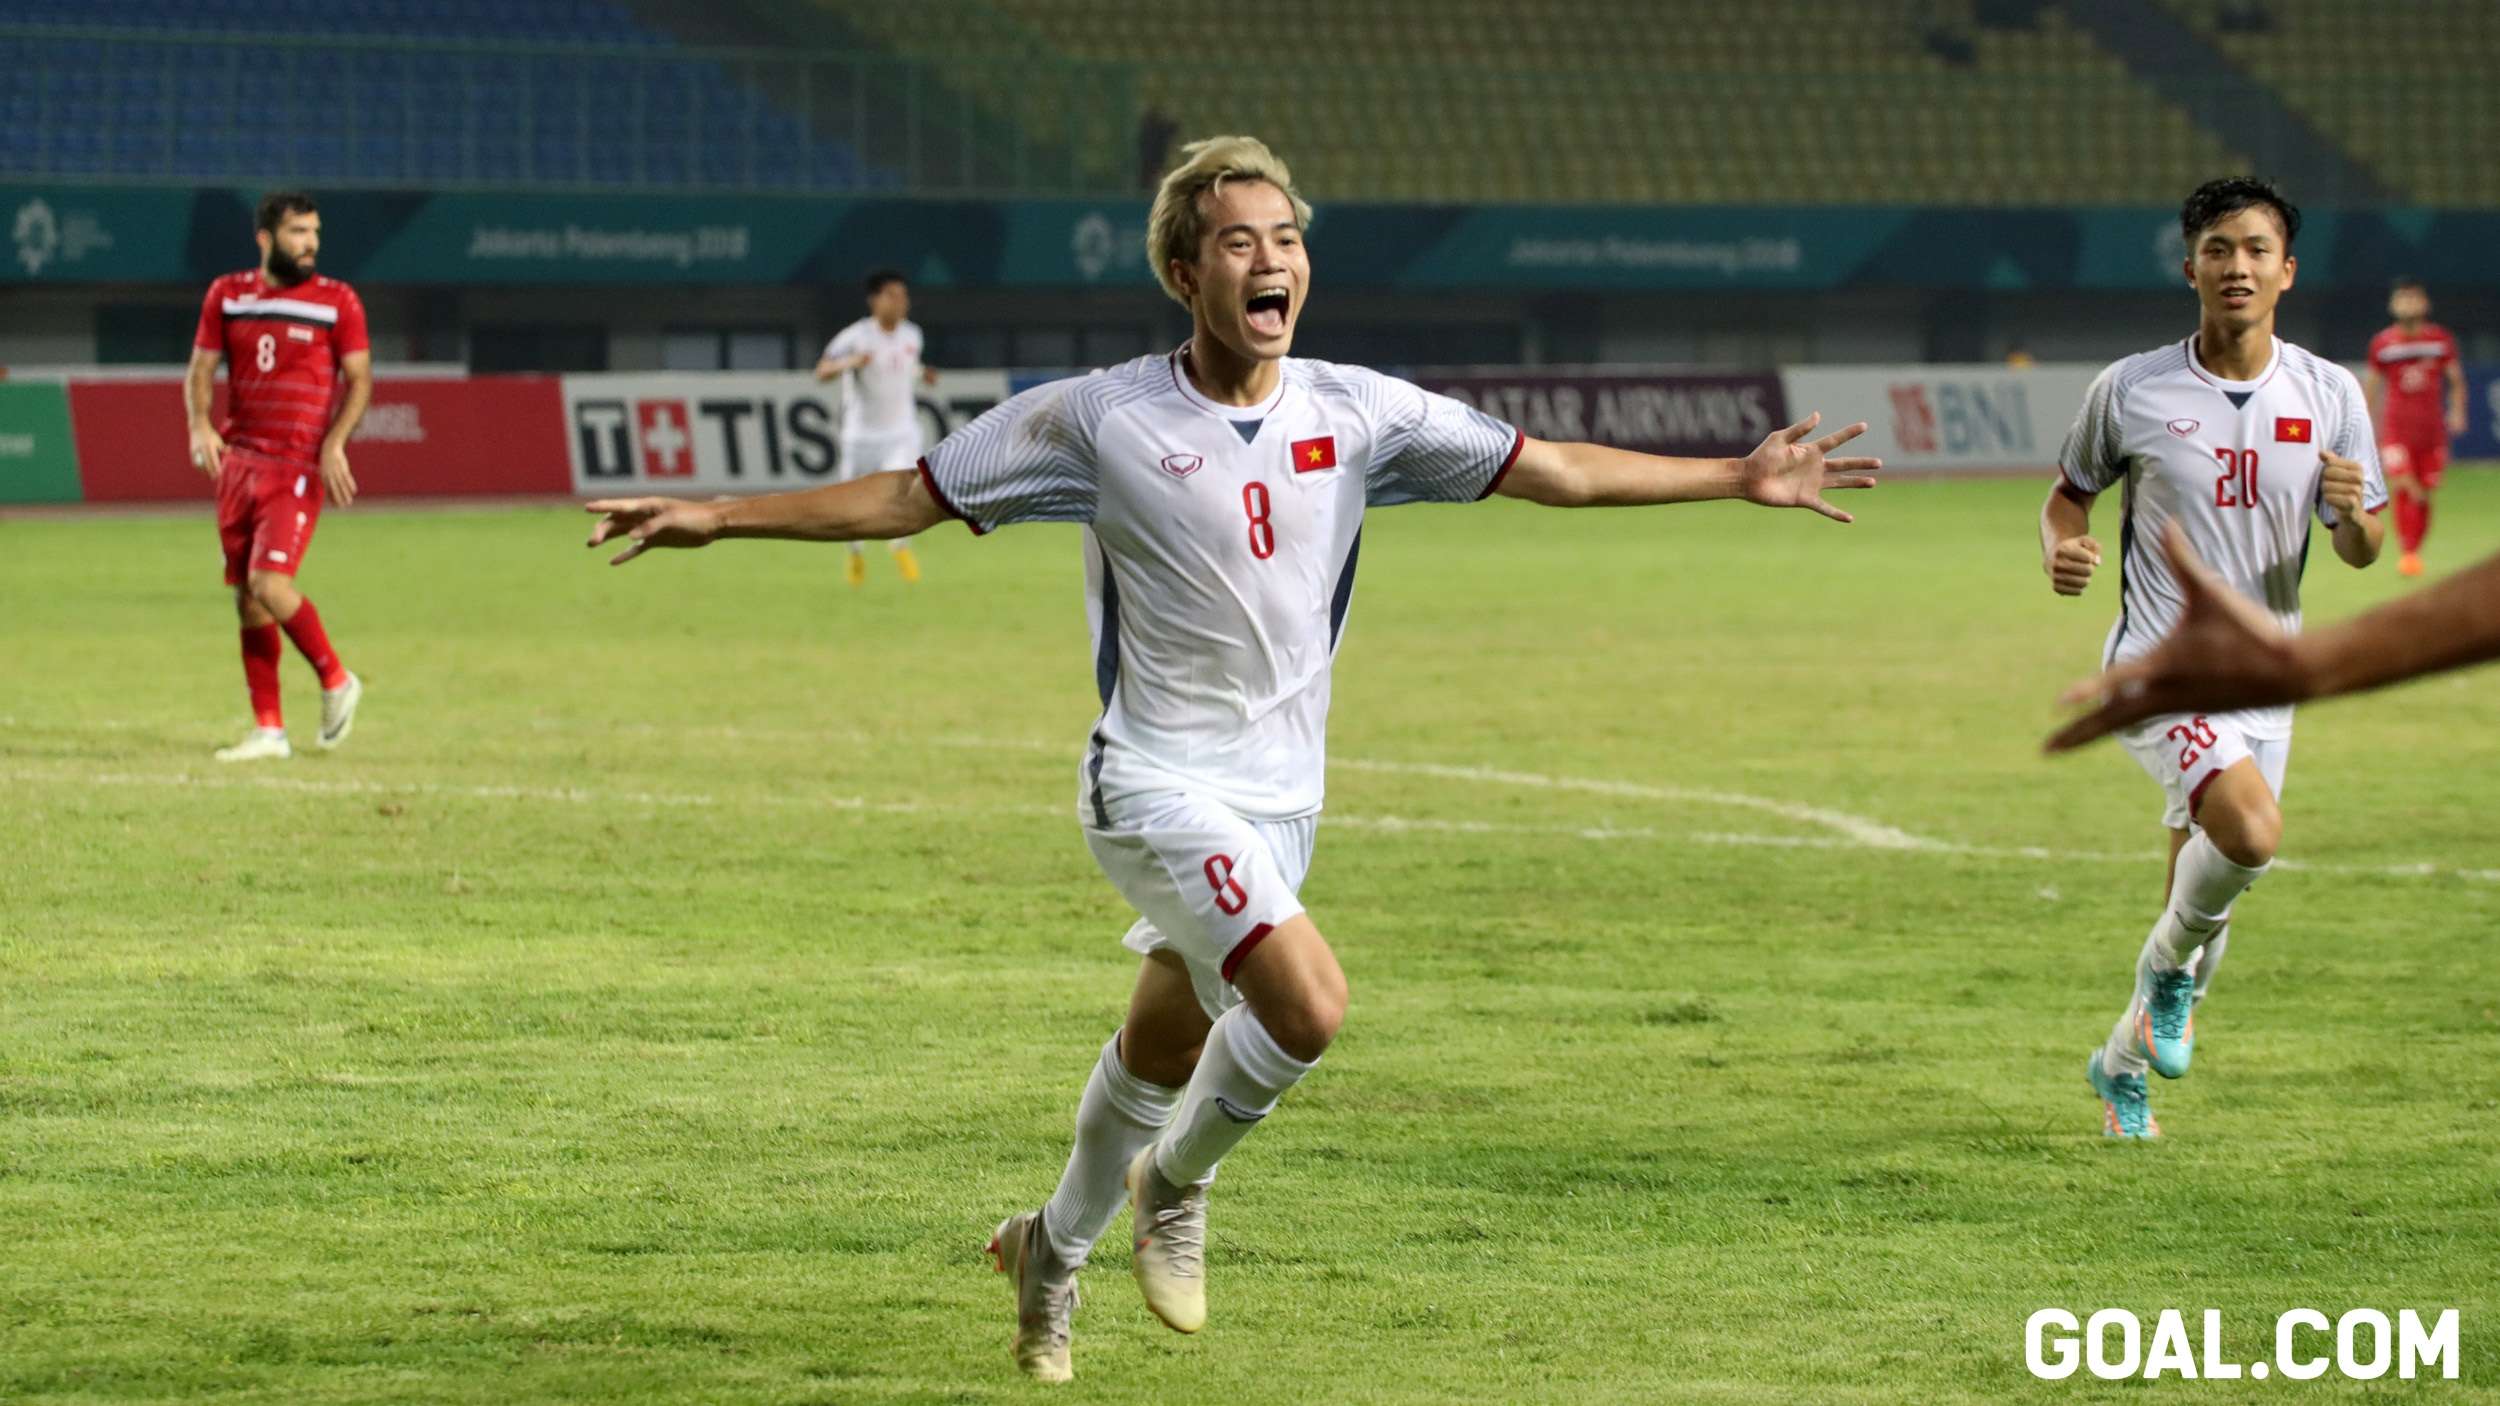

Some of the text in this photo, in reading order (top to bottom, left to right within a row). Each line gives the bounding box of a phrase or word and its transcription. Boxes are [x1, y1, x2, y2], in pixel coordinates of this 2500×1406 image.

[257, 334, 276, 373] 8
[700, 396, 1000, 478] TIS
[1593, 386, 1773, 445] AIRWAYS
[1938, 383, 2037, 454] BNI
[2215, 447, 2259, 509] 20
[1243, 481, 1275, 560] 8
[2166, 714, 2218, 772] 20
[1204, 853, 1248, 916] 8
